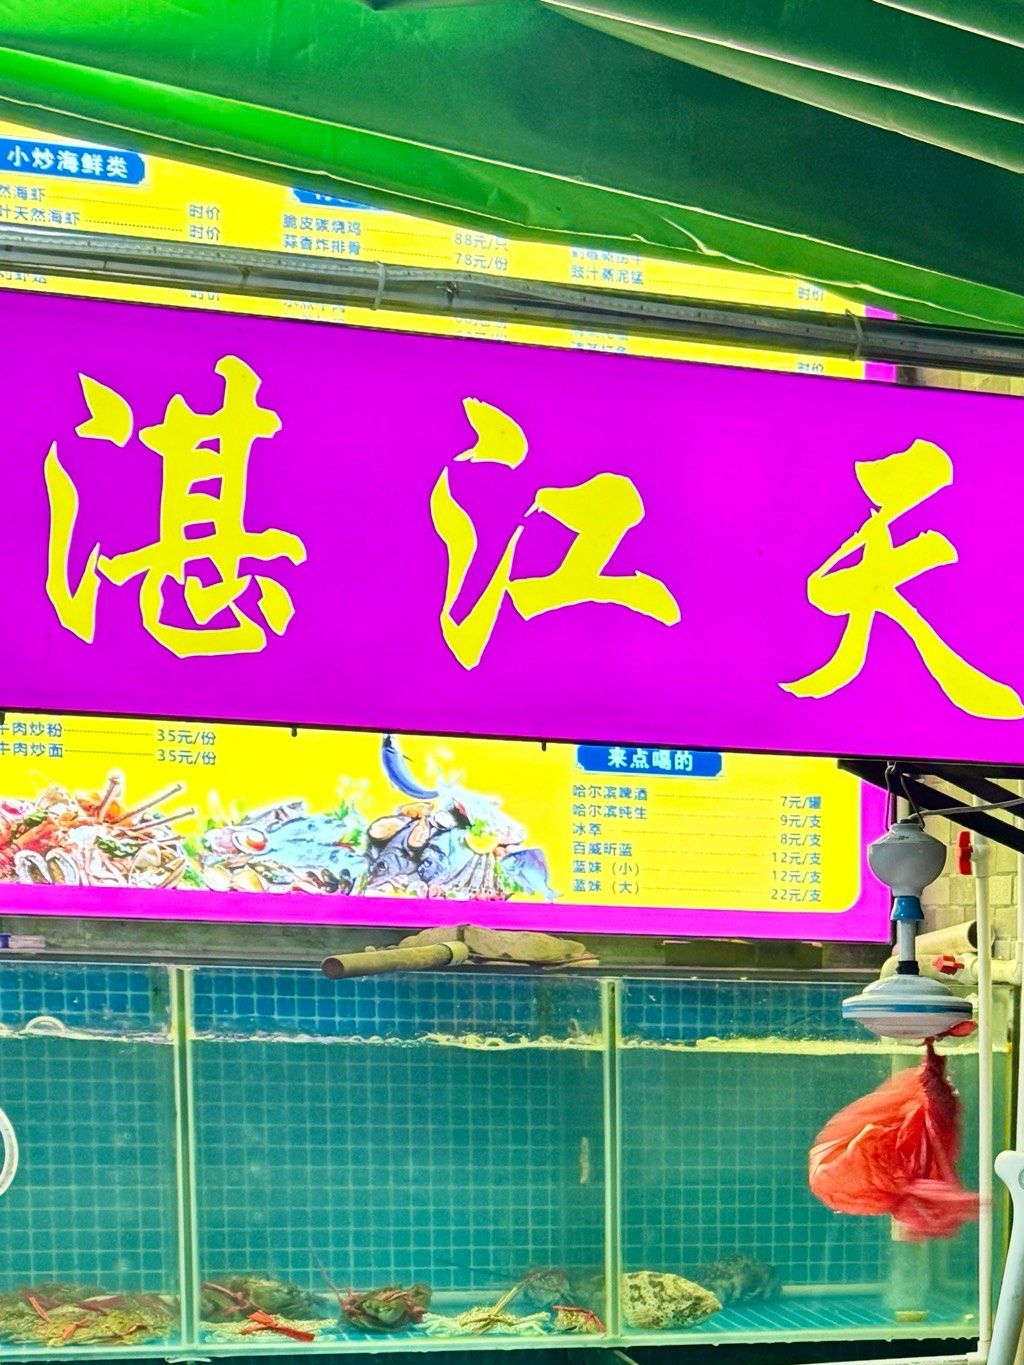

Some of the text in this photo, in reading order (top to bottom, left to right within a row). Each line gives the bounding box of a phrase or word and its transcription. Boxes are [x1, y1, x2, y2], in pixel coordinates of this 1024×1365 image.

[8, 145, 128, 178] 小炒海鲜类
[189, 204, 220, 220] 时价
[189, 225, 220, 241] 时价
[455, 253, 508, 271] 78元/份
[157, 728, 216, 746] 35元/份
[157, 748, 217, 766] 35元/份
[607, 747, 694, 772] 来点喝的
[573, 784, 648, 801] 哈尔滨啤酒
[573, 803, 822, 828] 哈尔滨纯生 9元/支
[780, 833, 822, 847] 8元/支
[772, 852, 822, 865] 12元/支
[772, 870, 822, 884] 12元/支
[771, 888, 822, 902] 22元/支
